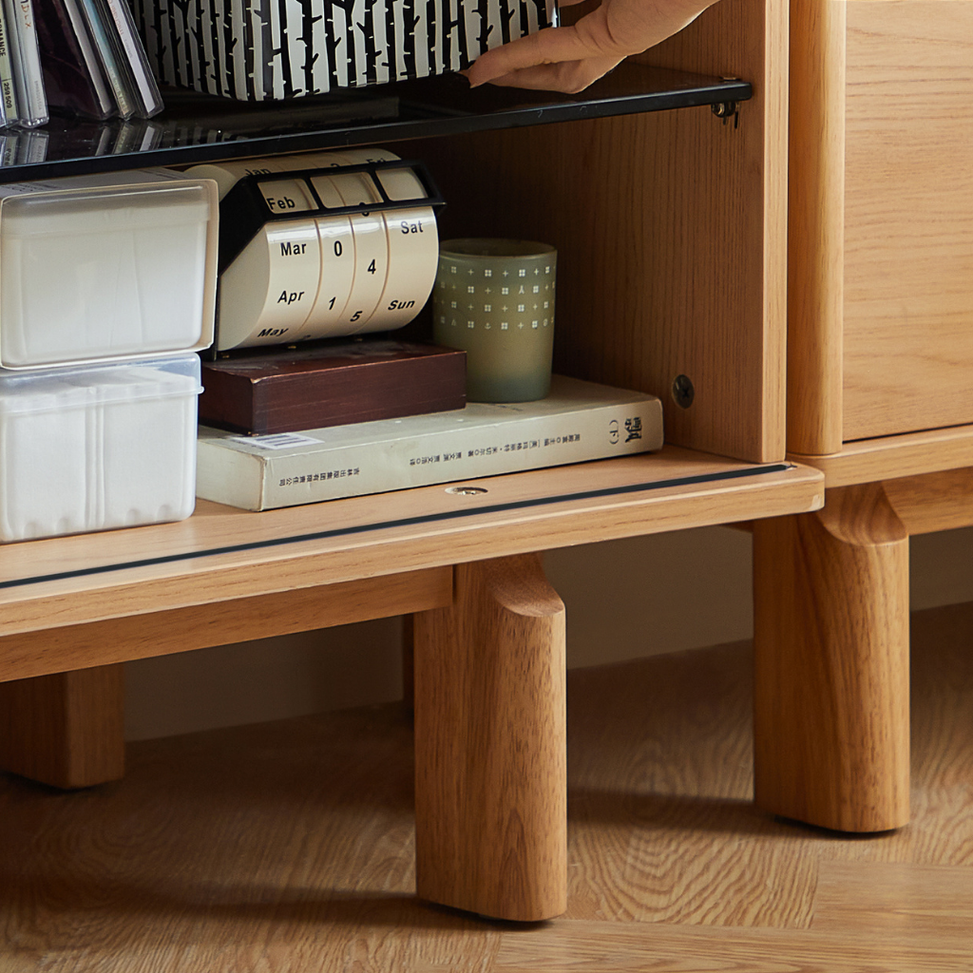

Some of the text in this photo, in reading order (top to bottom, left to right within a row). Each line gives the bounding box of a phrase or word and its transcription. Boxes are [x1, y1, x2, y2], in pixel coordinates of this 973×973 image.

[267, 196, 295, 211] Feb
[280, 220, 423, 257] Mar 0 Sat
[367, 259, 376, 274] 4
[277, 290, 415, 311] Apr 1 Sun
[350, 310, 363, 322] 5
[257, 328, 289, 337] May
[625, 416, 642, 443] 飘
